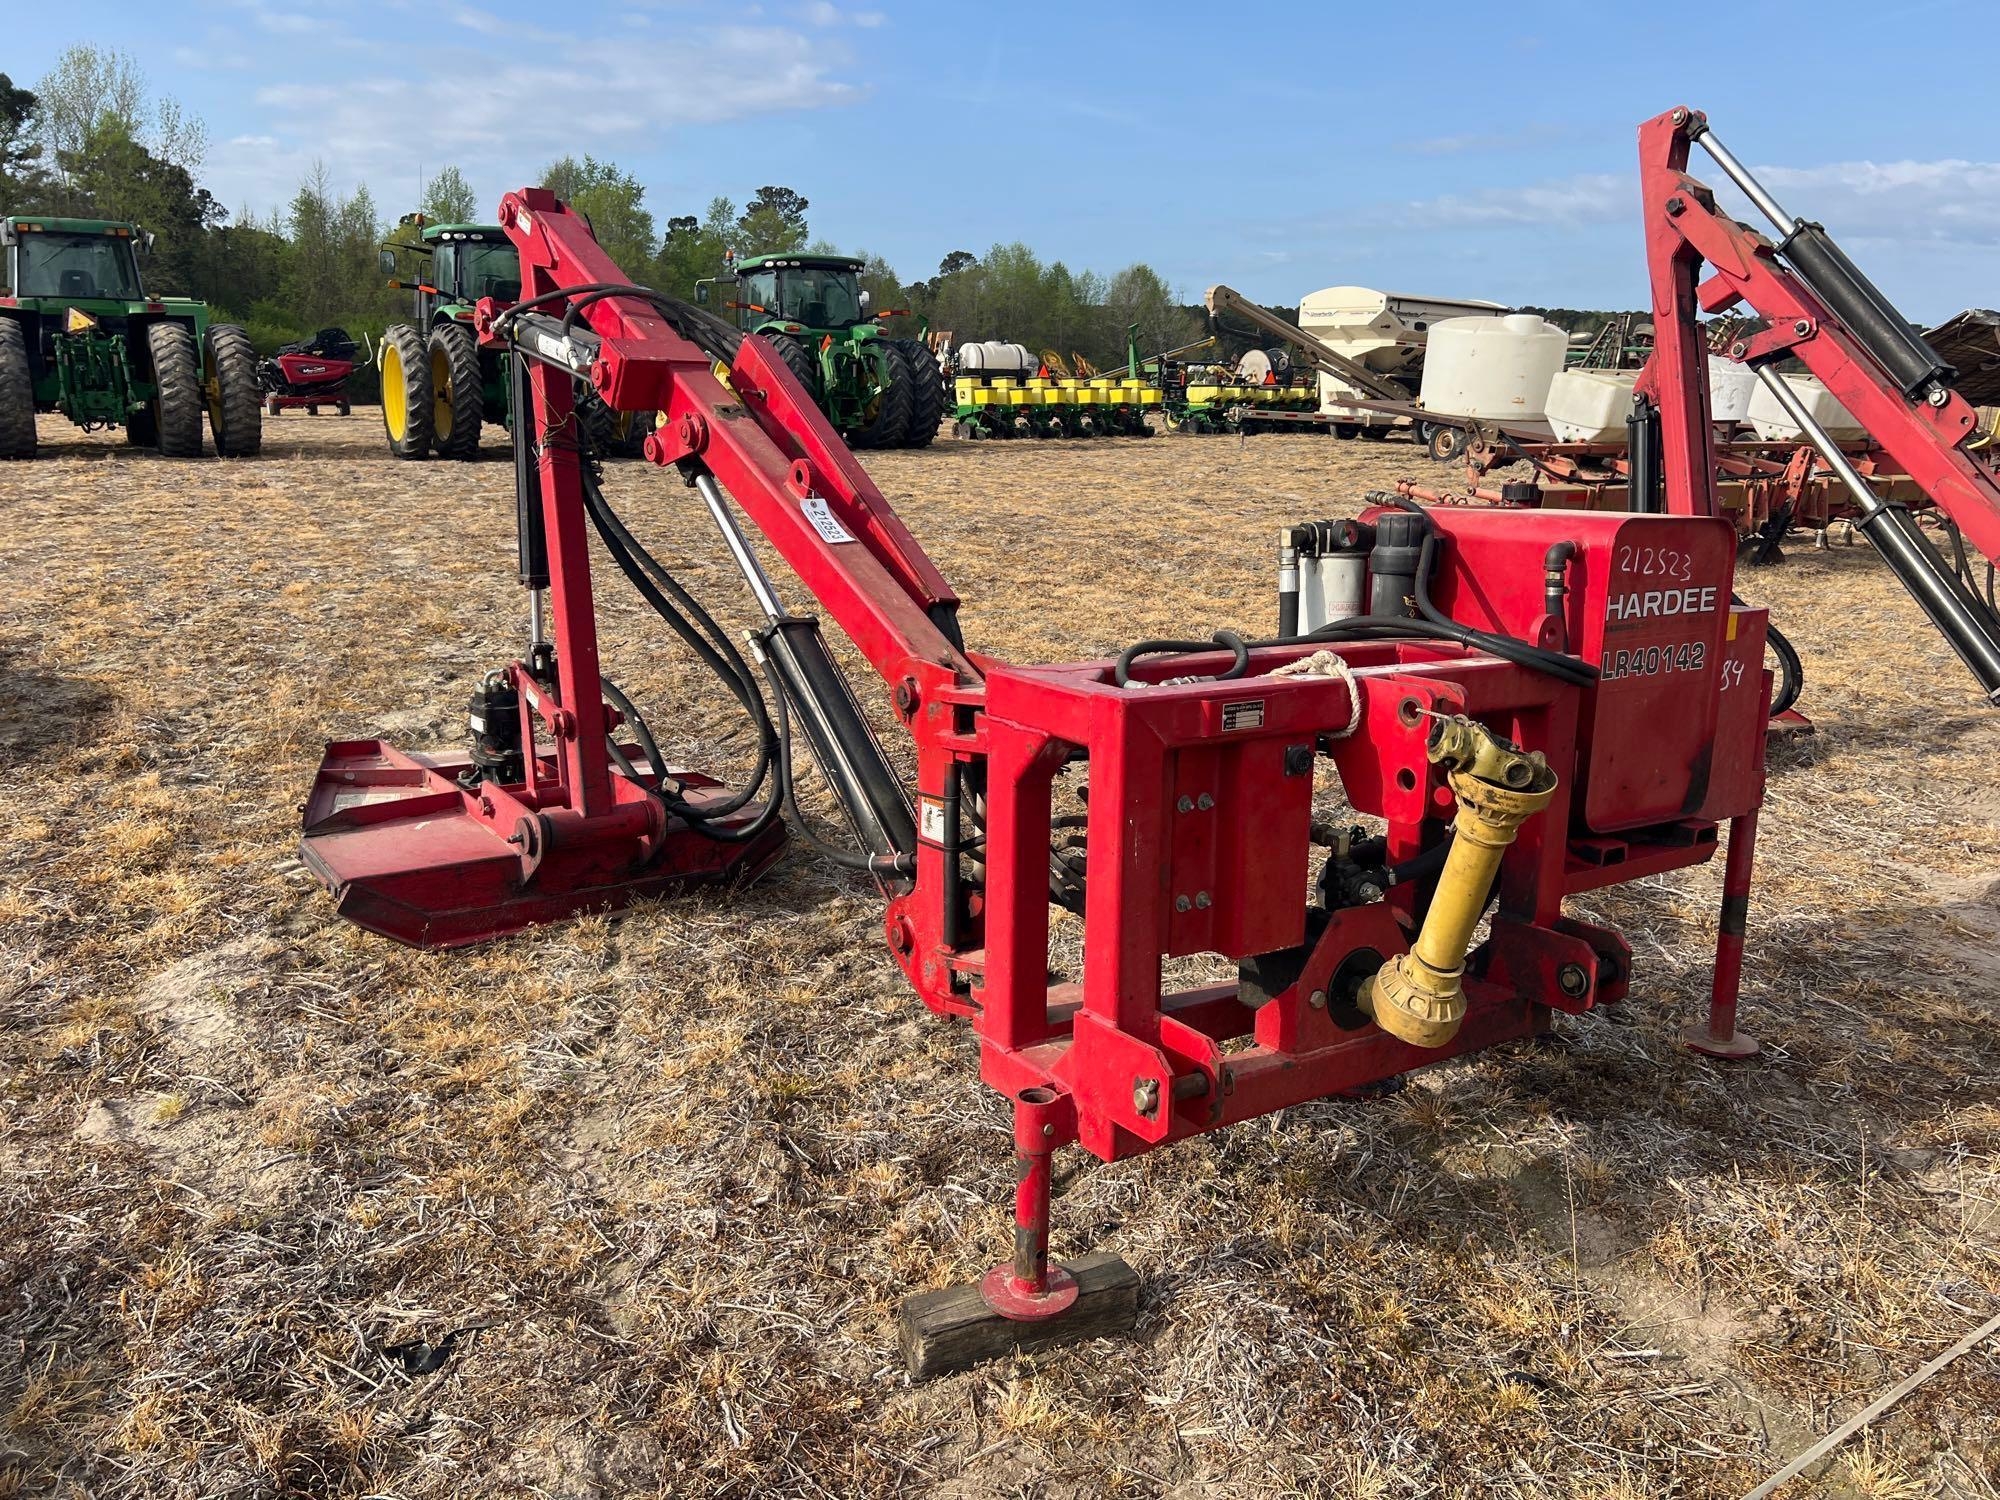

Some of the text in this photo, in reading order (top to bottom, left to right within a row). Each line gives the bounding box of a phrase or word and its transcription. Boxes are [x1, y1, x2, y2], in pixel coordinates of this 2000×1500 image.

[813, 510, 844, 540] 212523
[1620, 546, 1691, 581] 212523
[1606, 587, 1717, 620] HARDEE
[1601, 642, 1705, 680] LR40142
